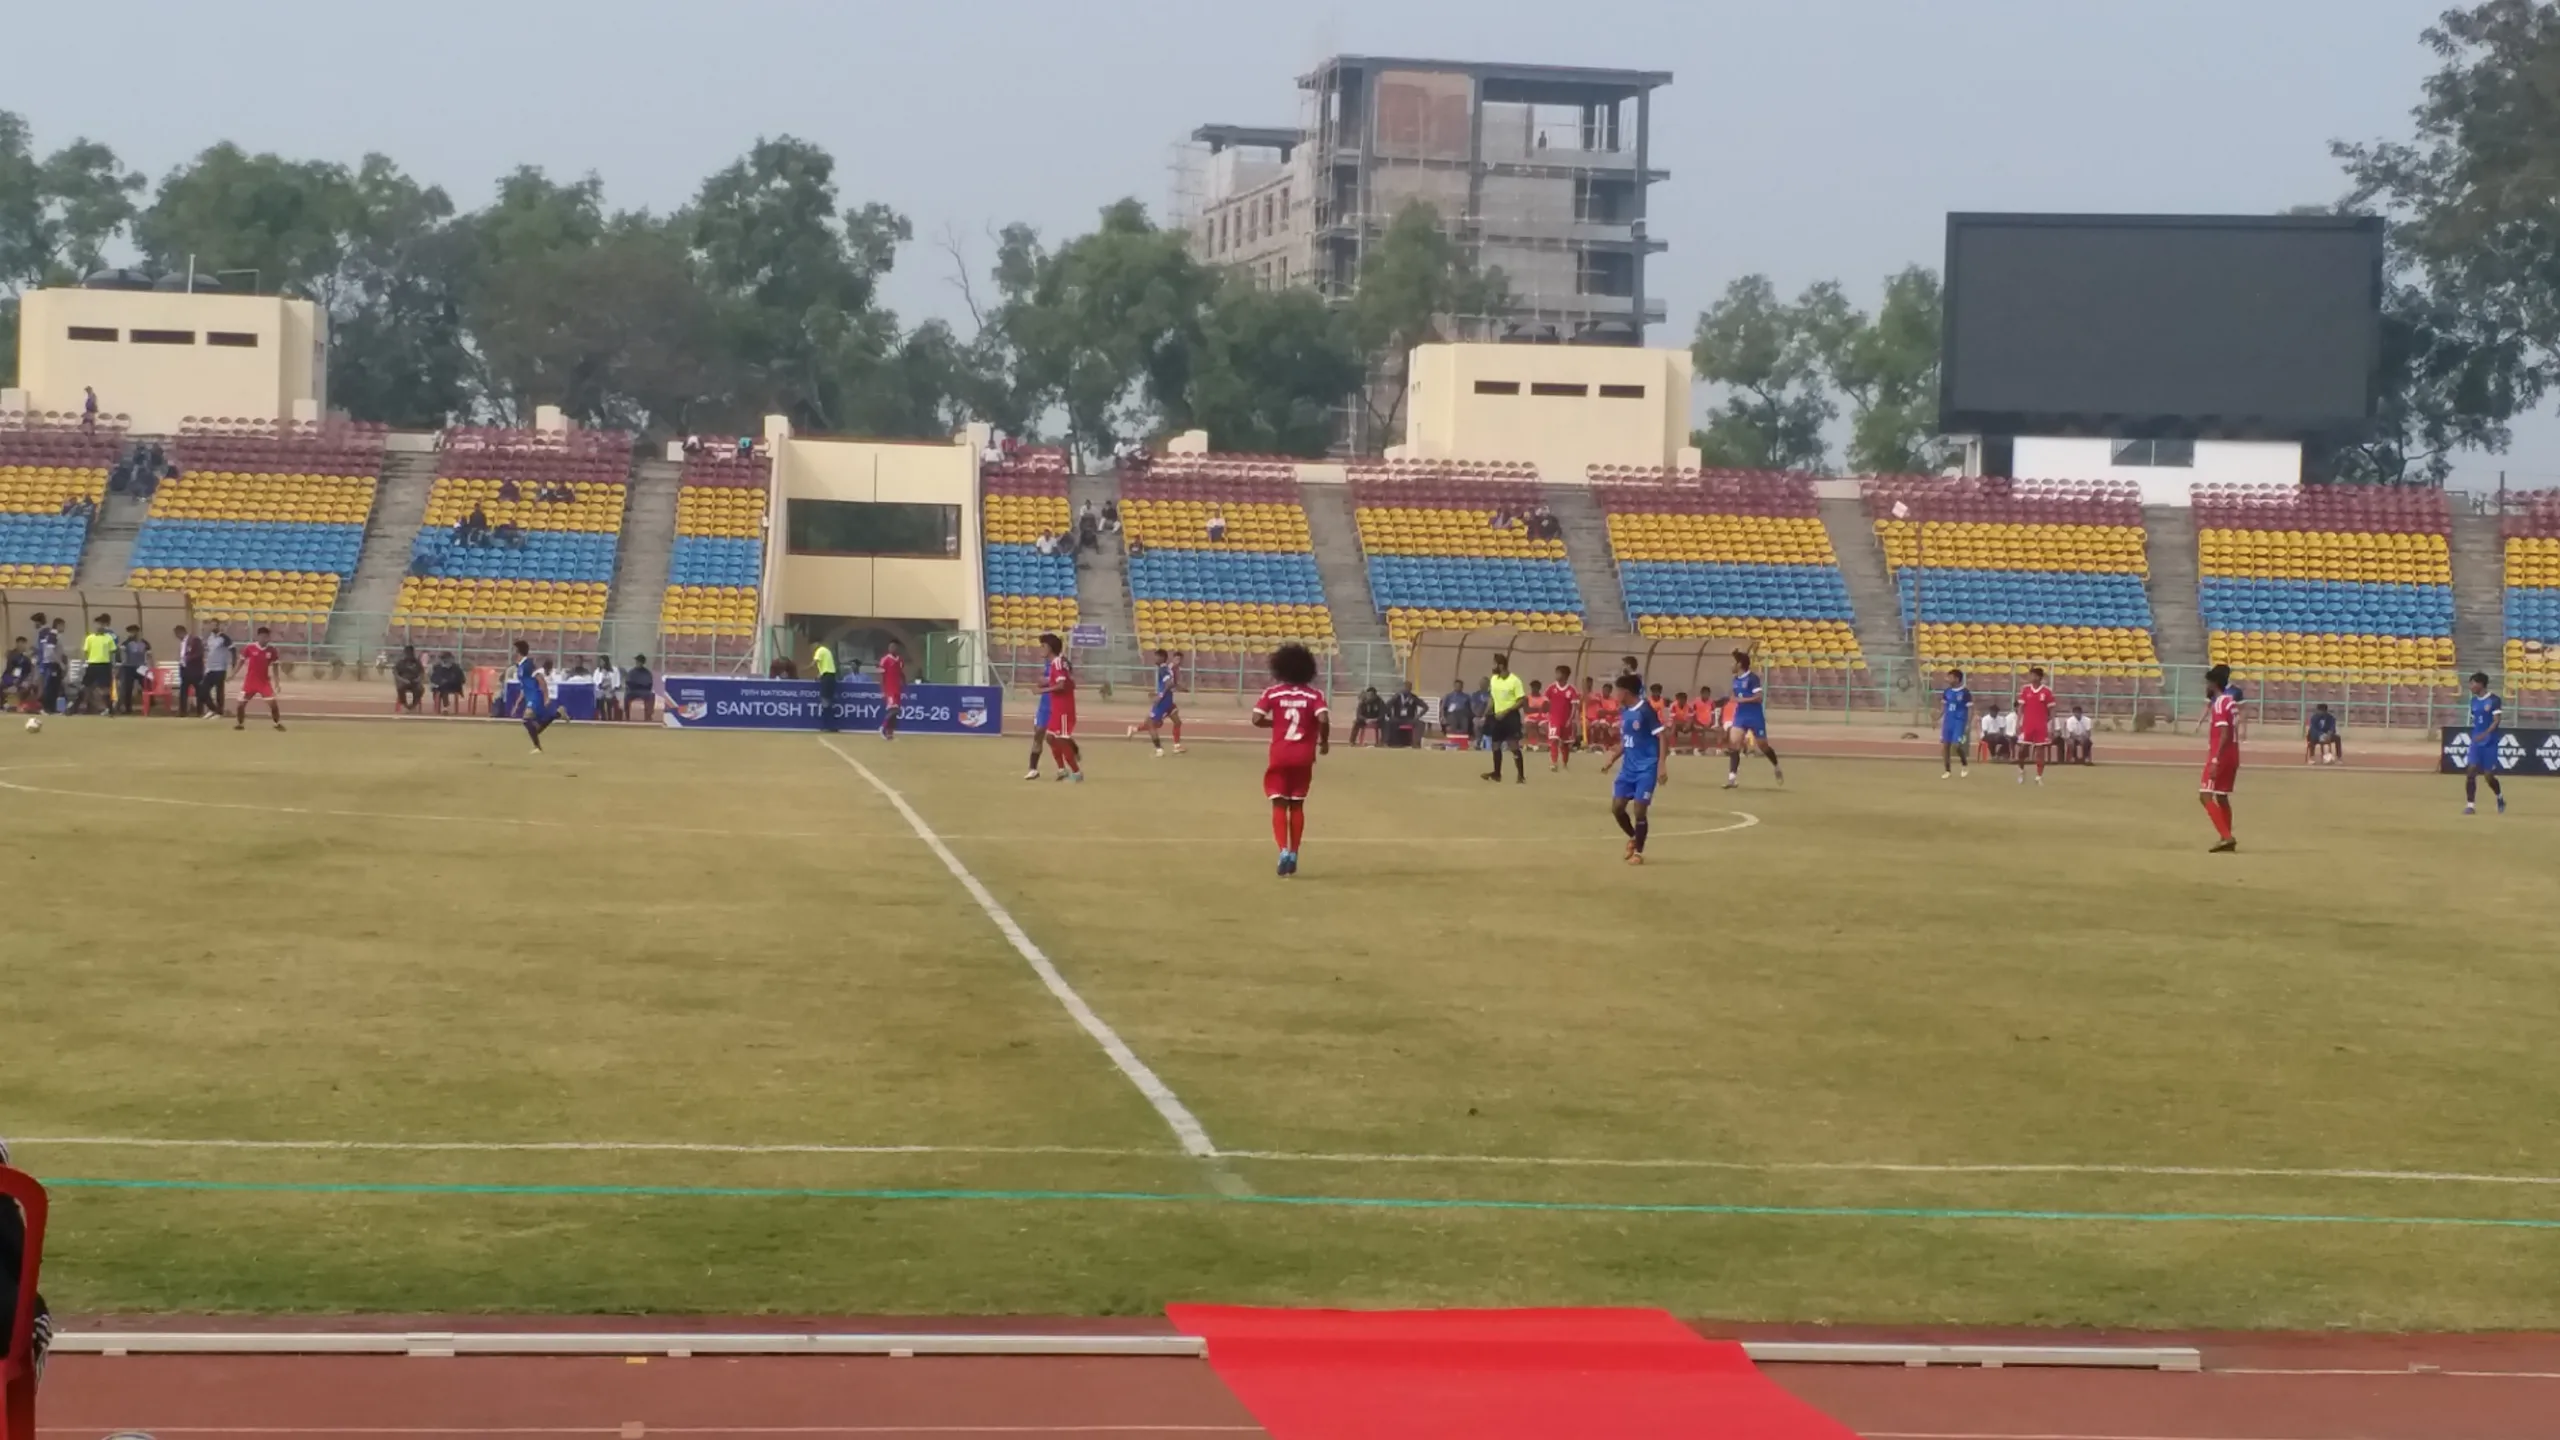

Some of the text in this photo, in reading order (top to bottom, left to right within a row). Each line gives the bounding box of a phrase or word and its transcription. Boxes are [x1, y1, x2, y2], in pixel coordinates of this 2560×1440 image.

[716, 701, 802, 717] SANTOSH
[896, 705, 950, 721] 025-26
[1284, 708, 1303, 740] 2
[2498, 748, 2526, 757] IVIA
